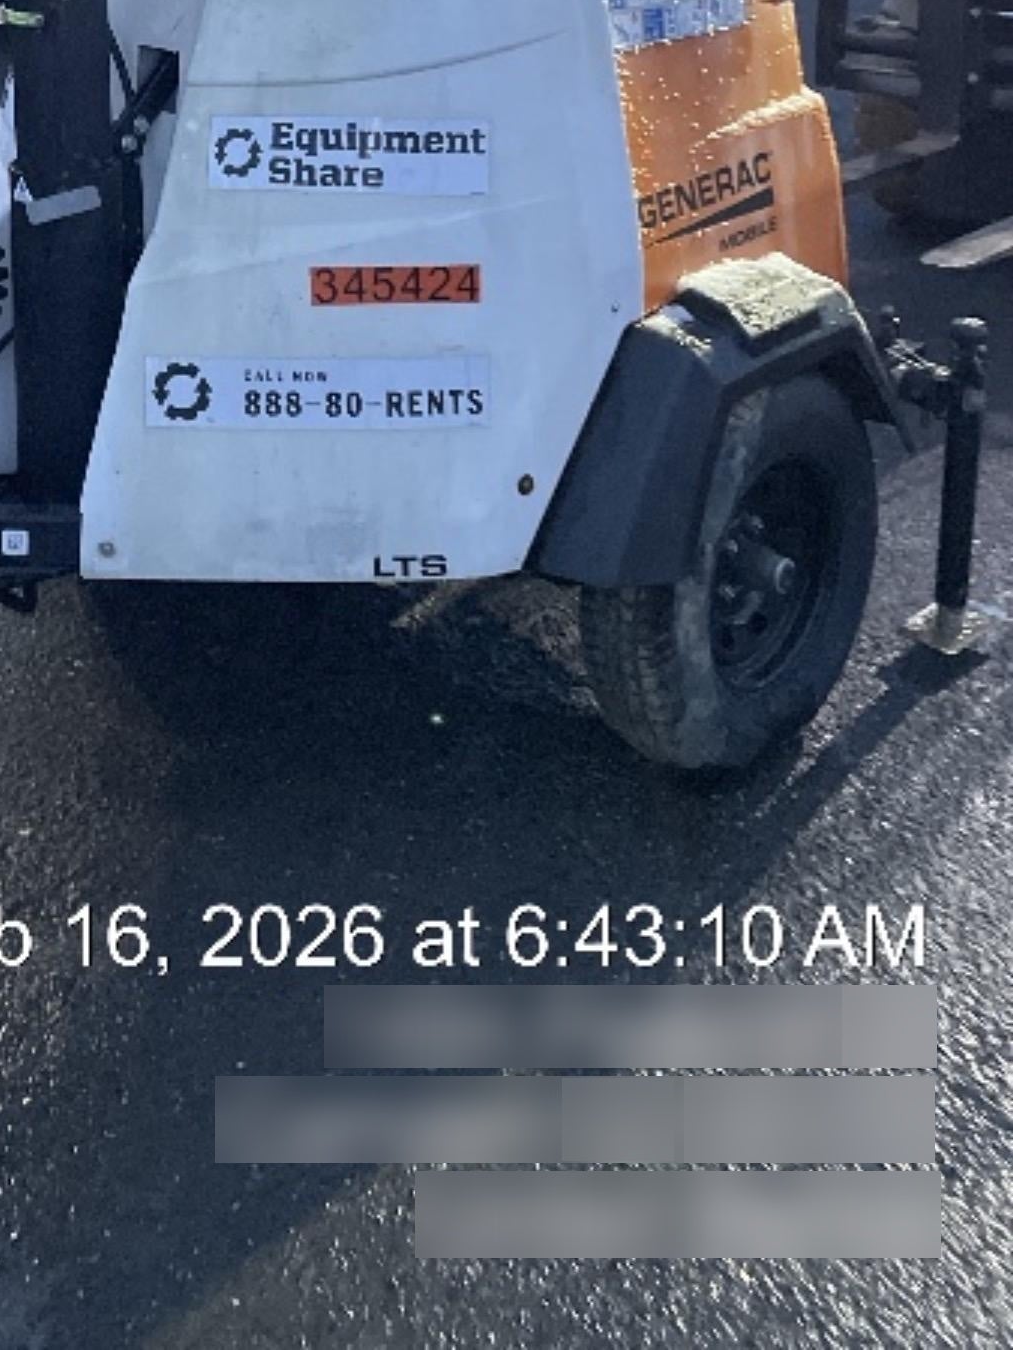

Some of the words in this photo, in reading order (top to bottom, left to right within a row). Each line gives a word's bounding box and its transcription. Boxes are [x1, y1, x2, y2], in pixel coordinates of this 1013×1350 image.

[270, 122, 486, 159] Equipment
[268, 157, 384, 187] Share
[638, 152, 772, 228] GENERAC
[314, 266, 479, 304] 345424
[244, 369, 284, 382] CALL
[244, 389, 484, 418] 888-80-RENTS
[373, 554, 447, 577] LTS
